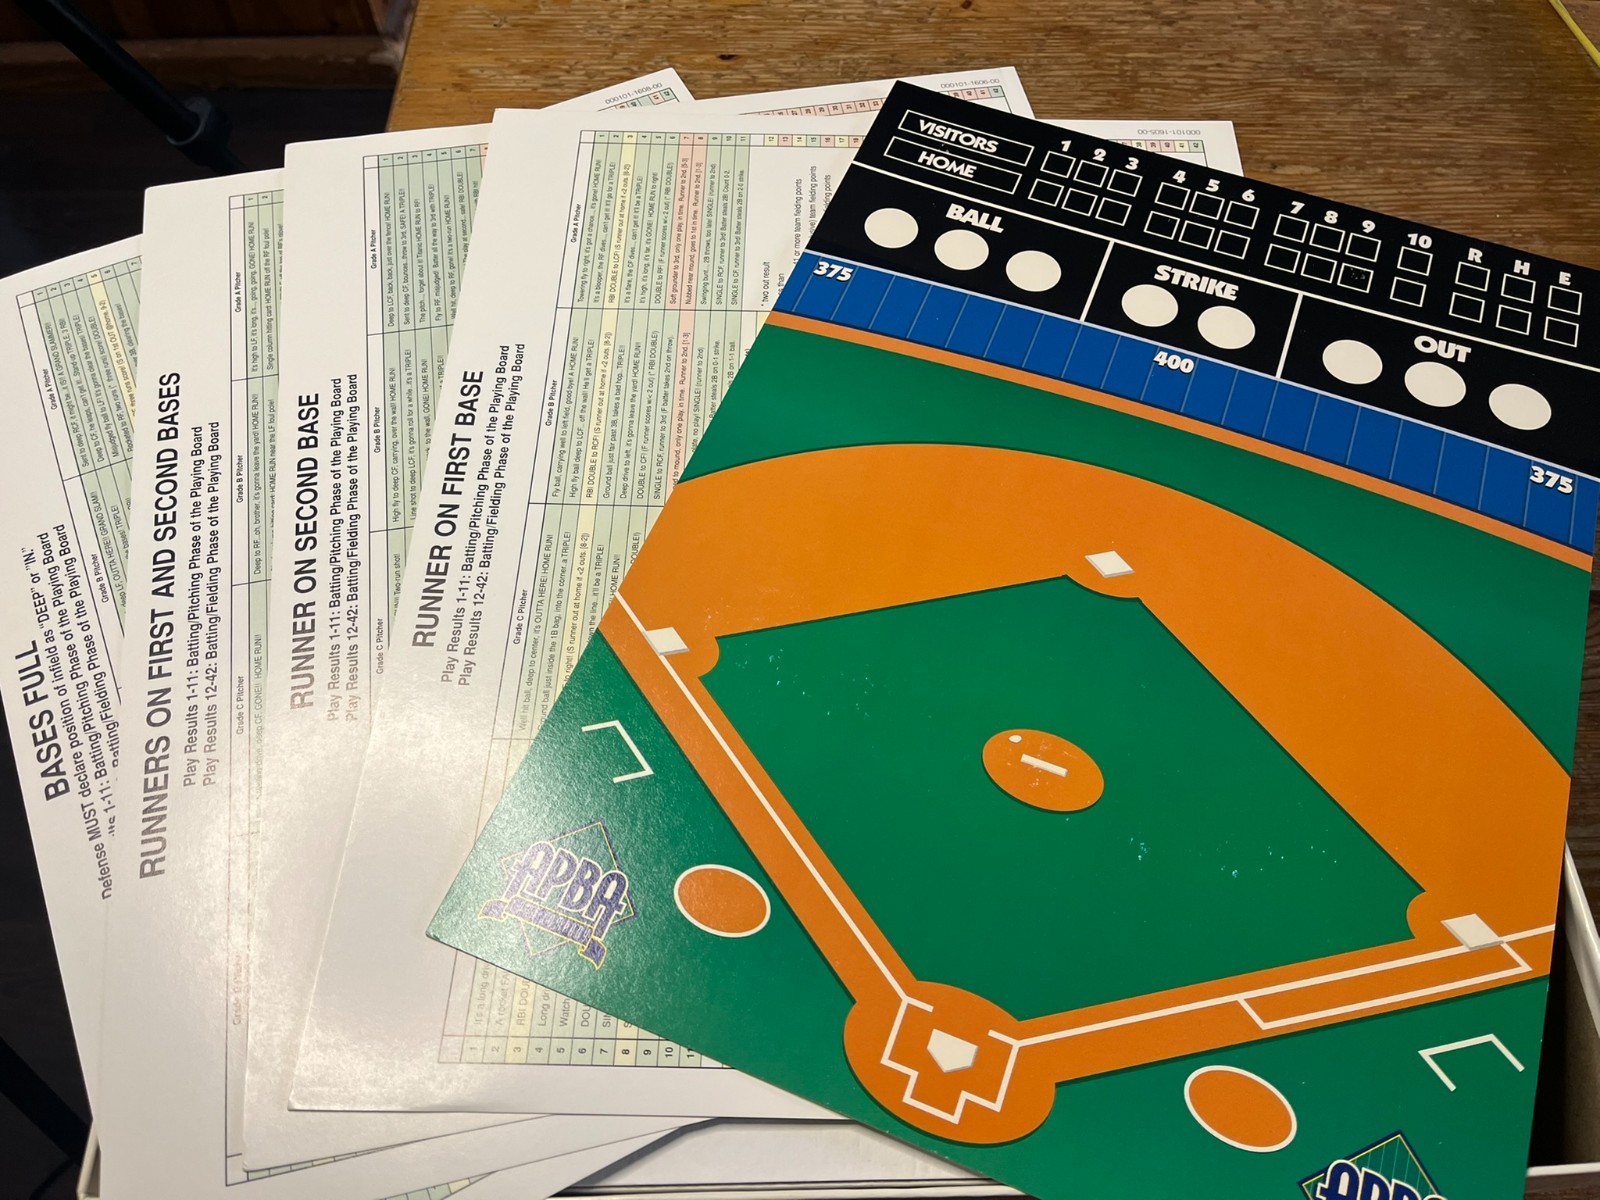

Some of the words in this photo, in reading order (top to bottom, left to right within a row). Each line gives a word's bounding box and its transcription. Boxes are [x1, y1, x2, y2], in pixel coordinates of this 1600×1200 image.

[919, 119, 999, 153] VISITORS
[918, 151, 977, 178] HOME
[573, 203, 581, 221] Pitcher
[946, 203, 1004, 233] BALL
[1060, 140, 1072, 152] 1
[1092, 148, 1106, 162] 2
[1125, 157, 1139, 170] 3
[1172, 170, 1186, 184] 4
[1205, 178, 1220, 192] 5
[1242, 189, 1256, 202] 6
[1290, 201, 1305, 214] 7
[1324, 210, 1338, 224] 8
[1362, 220, 1376, 234] 9
[1408, 233, 1432, 248] 10
[1468, 248, 1483, 263] R
[1514, 260, 1530, 276] H
[1558, 272, 1572, 286] E
[570, 227, 578, 243] Grade
[813, 261, 854, 282] 375
[1154, 264, 1240, 301] STRIKE
[495, 345, 510, 374] Board
[510, 343, 525, 372] Board
[1153, 350, 1194, 374] 400
[1414, 335, 1472, 363] OUT
[330, 378, 342, 407] Board
[346, 374, 358, 403] Board
[454, 370, 484, 426] BASE
[488, 377, 507, 413] Playing
[504, 375, 523, 411] Playing
[548, 379, 557, 401] Pitcher
[157, 372, 180, 441] BASES
[297, 393, 319, 449] BASE
[502, 414, 514, 430] the
[544, 407, 554, 426] Grade
[207, 421, 219, 452] Board
[330, 410, 344, 447] Playing
[346, 405, 360, 443] Playing
[484, 435, 495, 446] of
[486, 416, 498, 432] the
[500, 433, 511, 444] of
[190, 426, 202, 456] Board
[346, 445, 358, 462] the
[207, 454, 222, 493] Playing
[330, 450, 342, 466] the
[330, 469, 341, 480] of
[346, 464, 358, 475] of
[441, 432, 472, 495] FIRST
[476, 448, 493, 481] Phase
[493, 446, 509, 478] Phase
[153, 448, 178, 542] SECOND
[189, 459, 205, 498] Playing
[236, 484, 244, 503] Grade
[346, 478, 358, 511] Phase
[1530, 466, 1573, 494] 375
[189, 501, 202, 518] the
[207, 495, 219, 513] the
[294, 457, 318, 551] SECOND
[329, 482, 341, 516] Phase
[189, 521, 201, 532] of
[207, 516, 219, 527] of
[434, 503, 460, 537] ON
[460, 484, 489, 571] Batting/Pitching
[478, 482, 506, 568] Batting/Fielding
[36, 532, 55, 564] Board
[52, 524, 71, 557] Board
[188, 535, 201, 569] Phase
[206, 530, 219, 564] Phase
[91, 553, 102, 576] Pitcher
[151, 549, 176, 598] AND
[328, 518, 344, 608] Batting/Pitching
[346, 513, 361, 602] Batting/Fielding
[30, 572, 41, 583] or
[47, 565, 65, 608] Playing
[64, 557, 82, 599] Playing
[98, 582, 109, 603] Grade
[293, 558, 317, 594] ON
[456, 575, 471, 603] 1-11:
[472, 572, 489, 606] 12-42:
[74, 599, 87, 619] the
[205, 566, 222, 659] Batting/Fielding
[412, 545, 453, 647] RUNNER
[517, 589, 528, 614] Pitcher
[57, 608, 70, 628] the
[76, 620, 91, 632] of
[186, 572, 204, 667] Batting/Pitching
[328, 611, 340, 640] 1-11:
[346, 604, 358, 640] 12-42:
[446, 607, 466, 652] Results
[463, 610, 482, 655] Results
[512, 622, 523, 645] Grade
[40, 627, 55, 643] as
[59, 629, 74, 641] of
[148, 608, 174, 680] FIRST
[44, 642, 64, 682] infield
[66, 643, 83, 680] Phase
[83, 634, 100, 671] Phase
[291, 600, 316, 707] RUNNER
[327, 643, 340, 690] Results
[346, 644, 358, 690] Results
[440, 656, 459, 682] Play
[14, 639, 48, 700] FULL
[186, 670, 199, 701] 1-11:
[204, 662, 217, 700] 12-42:
[458, 659, 476, 686] Play
[53, 684, 68, 696] of
[60, 698, 83, 748] position
[146, 687, 172, 727] ON
[327, 694, 342, 721] Play
[345, 694, 360, 722] Play
[75, 680, 108, 780] Batting/Pitching
[184, 704, 198, 754] Results
[203, 704, 217, 753] Results
[28, 709, 70, 800] BASES
[72, 751, 92, 798] declare
[183, 758, 200, 787] Play
[202, 757, 220, 786] Play
[98, 780, 116, 813] 1-11:
[139, 735, 170, 879] RUNNERS
[80, 802, 102, 841] MUST
[502, 841, 630, 940] APBA
